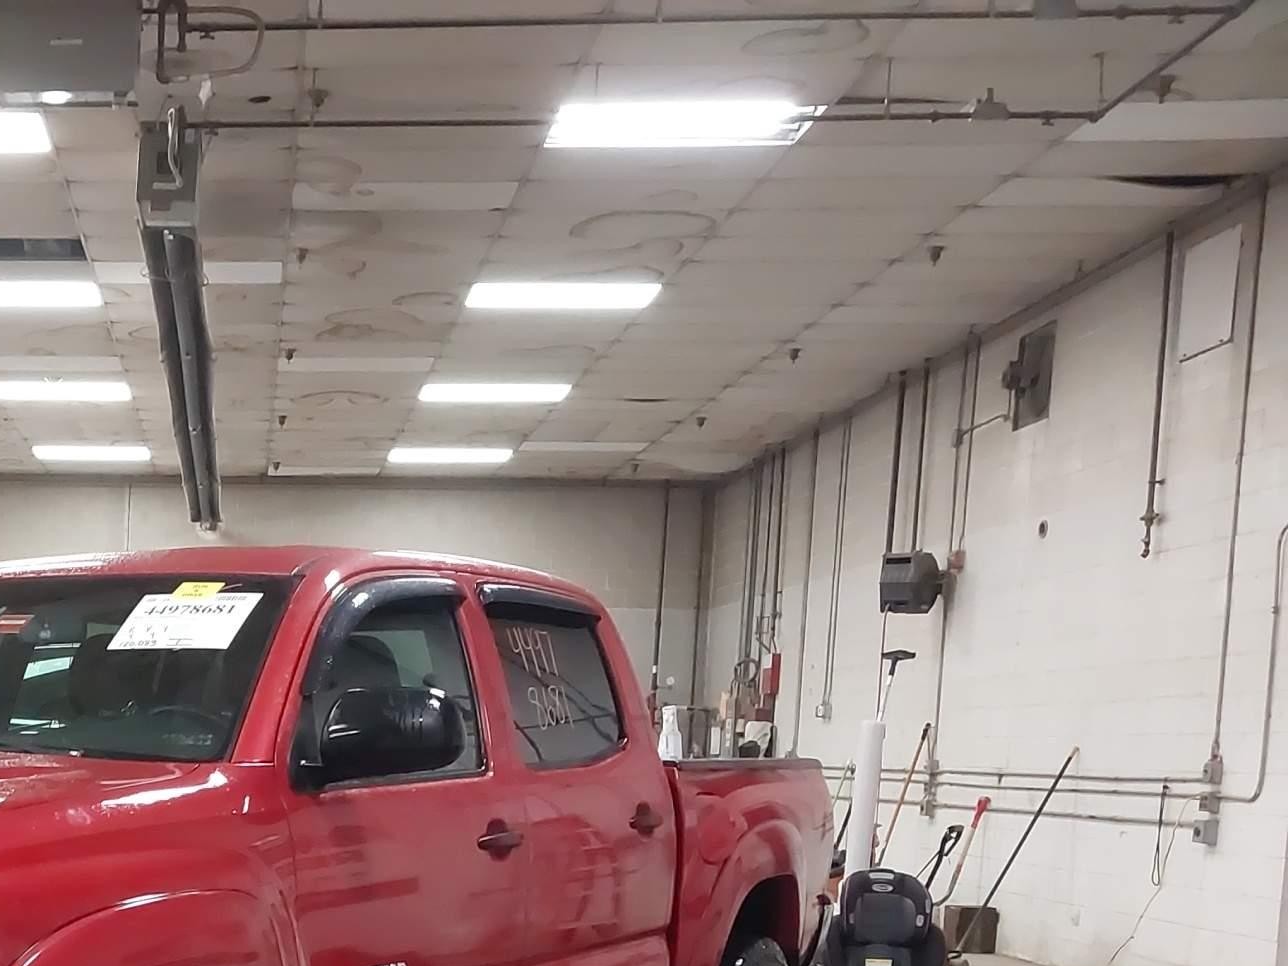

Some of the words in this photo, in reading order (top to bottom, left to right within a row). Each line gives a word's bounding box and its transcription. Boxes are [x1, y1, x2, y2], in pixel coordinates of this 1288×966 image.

[144, 604, 236, 616] 44978681
[505, 626, 560, 678] 4497
[527, 685, 575, 731] 8681
